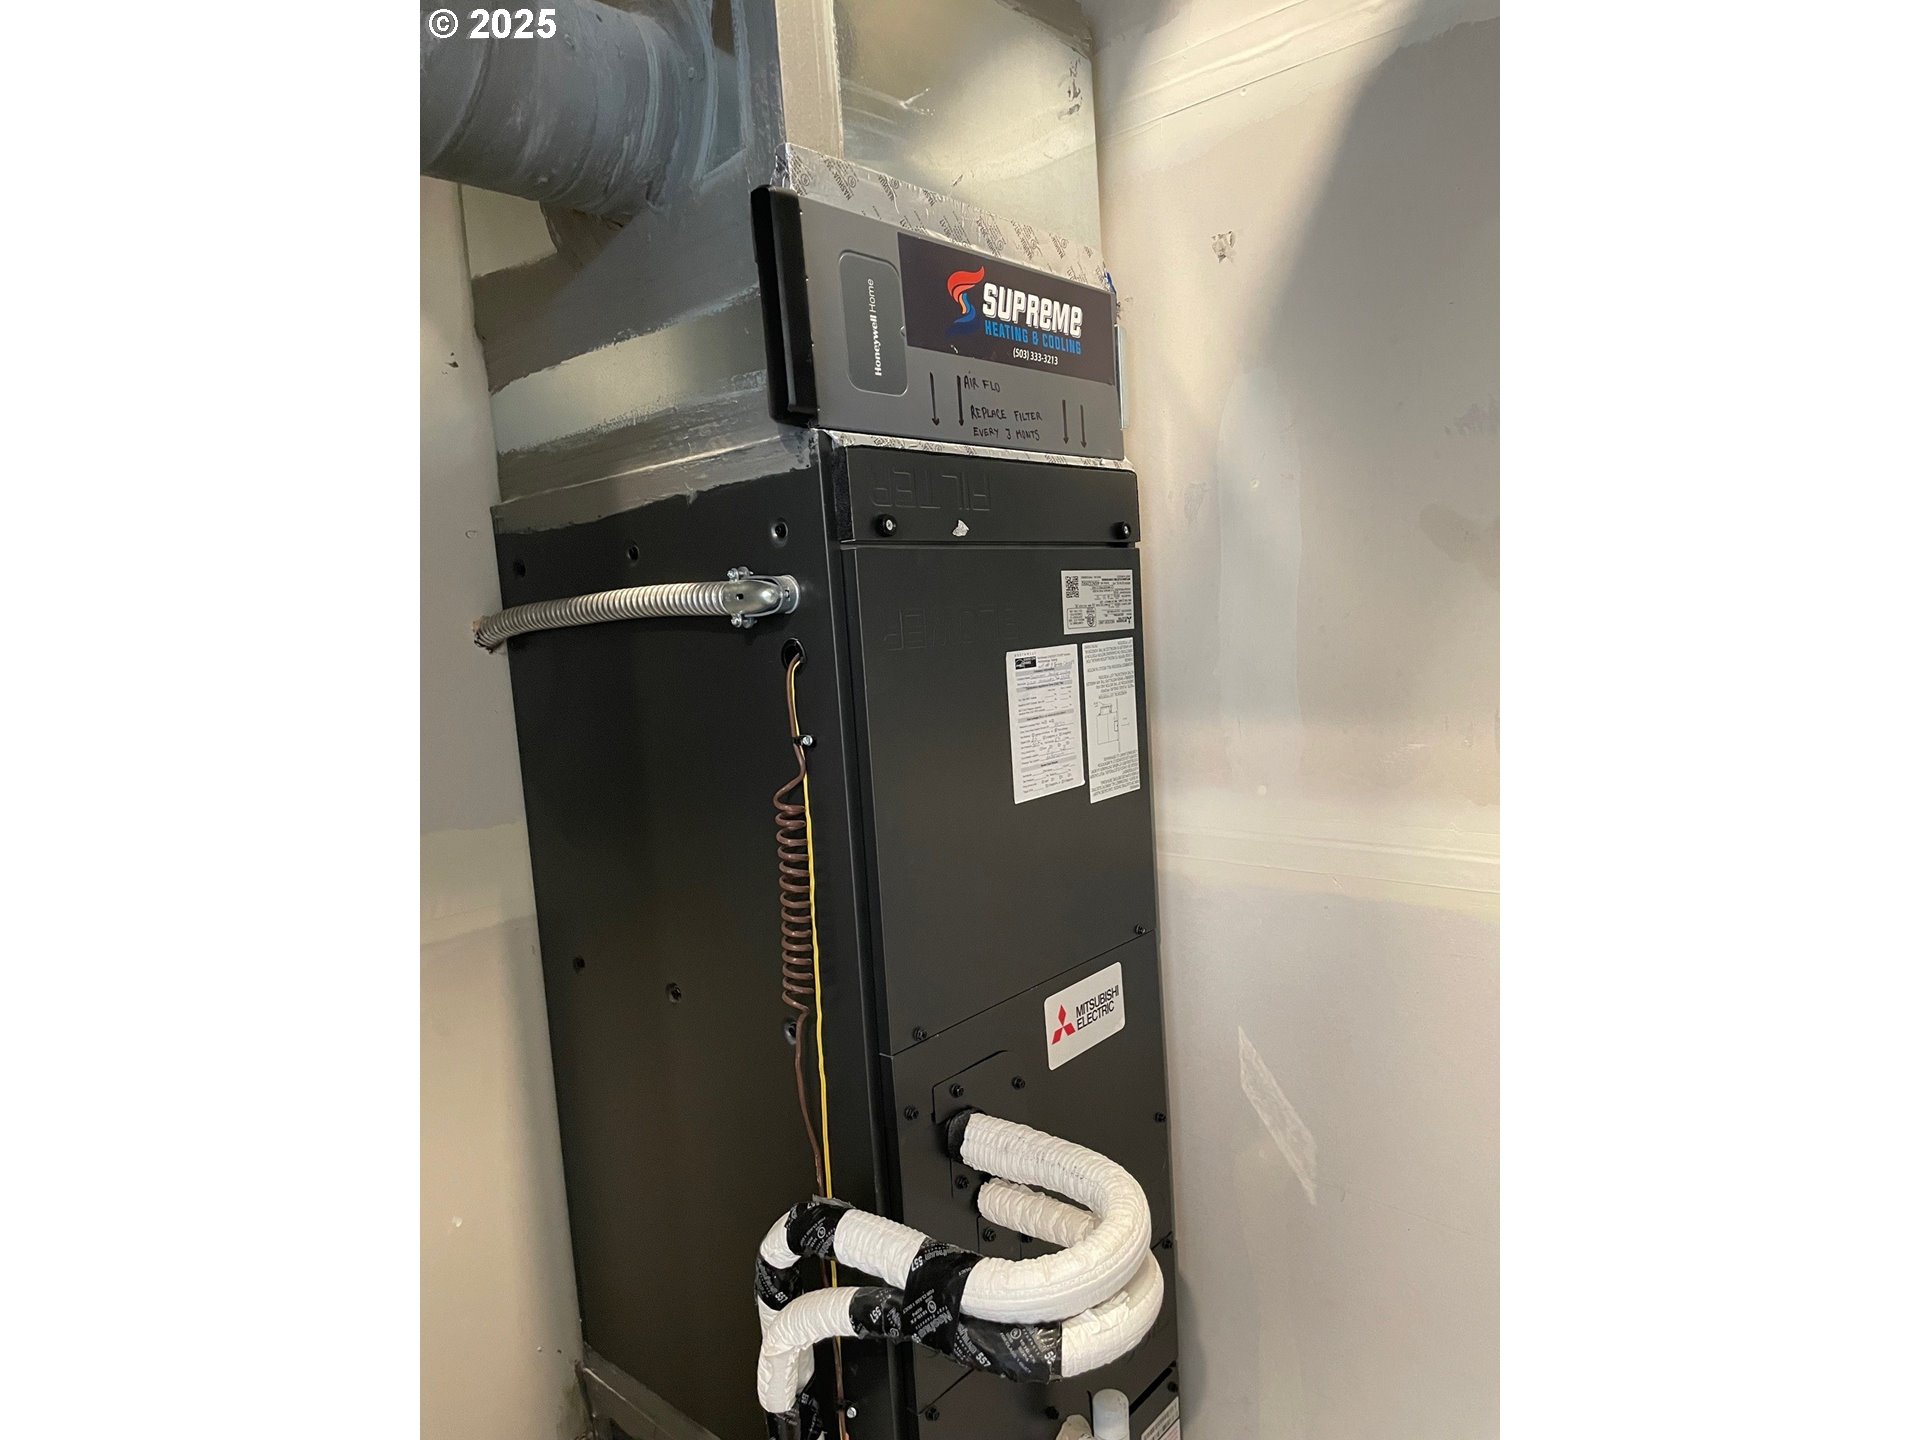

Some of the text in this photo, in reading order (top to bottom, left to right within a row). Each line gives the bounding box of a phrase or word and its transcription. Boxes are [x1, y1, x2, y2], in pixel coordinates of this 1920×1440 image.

[867, 279, 882, 376] Honeywell Home
[984, 320, 1082, 355] HEATING & COOLING
[1012, 347, 1059, 366] (503) 333-3213
[964, 375, 1001, 393] AIR FLO
[970, 404, 1043, 422] REPLACE FILTER
[973, 427, 1040, 441] EVERY 3 MONTS
[869, 466, 991, 512] FILTER
[1075, 984, 1120, 1019] MITSUBISHI
[1077, 1000, 1115, 1031] ELECTRIC
[869, 1306, 882, 1324] 557
[975, 1351, 991, 1366] 557
